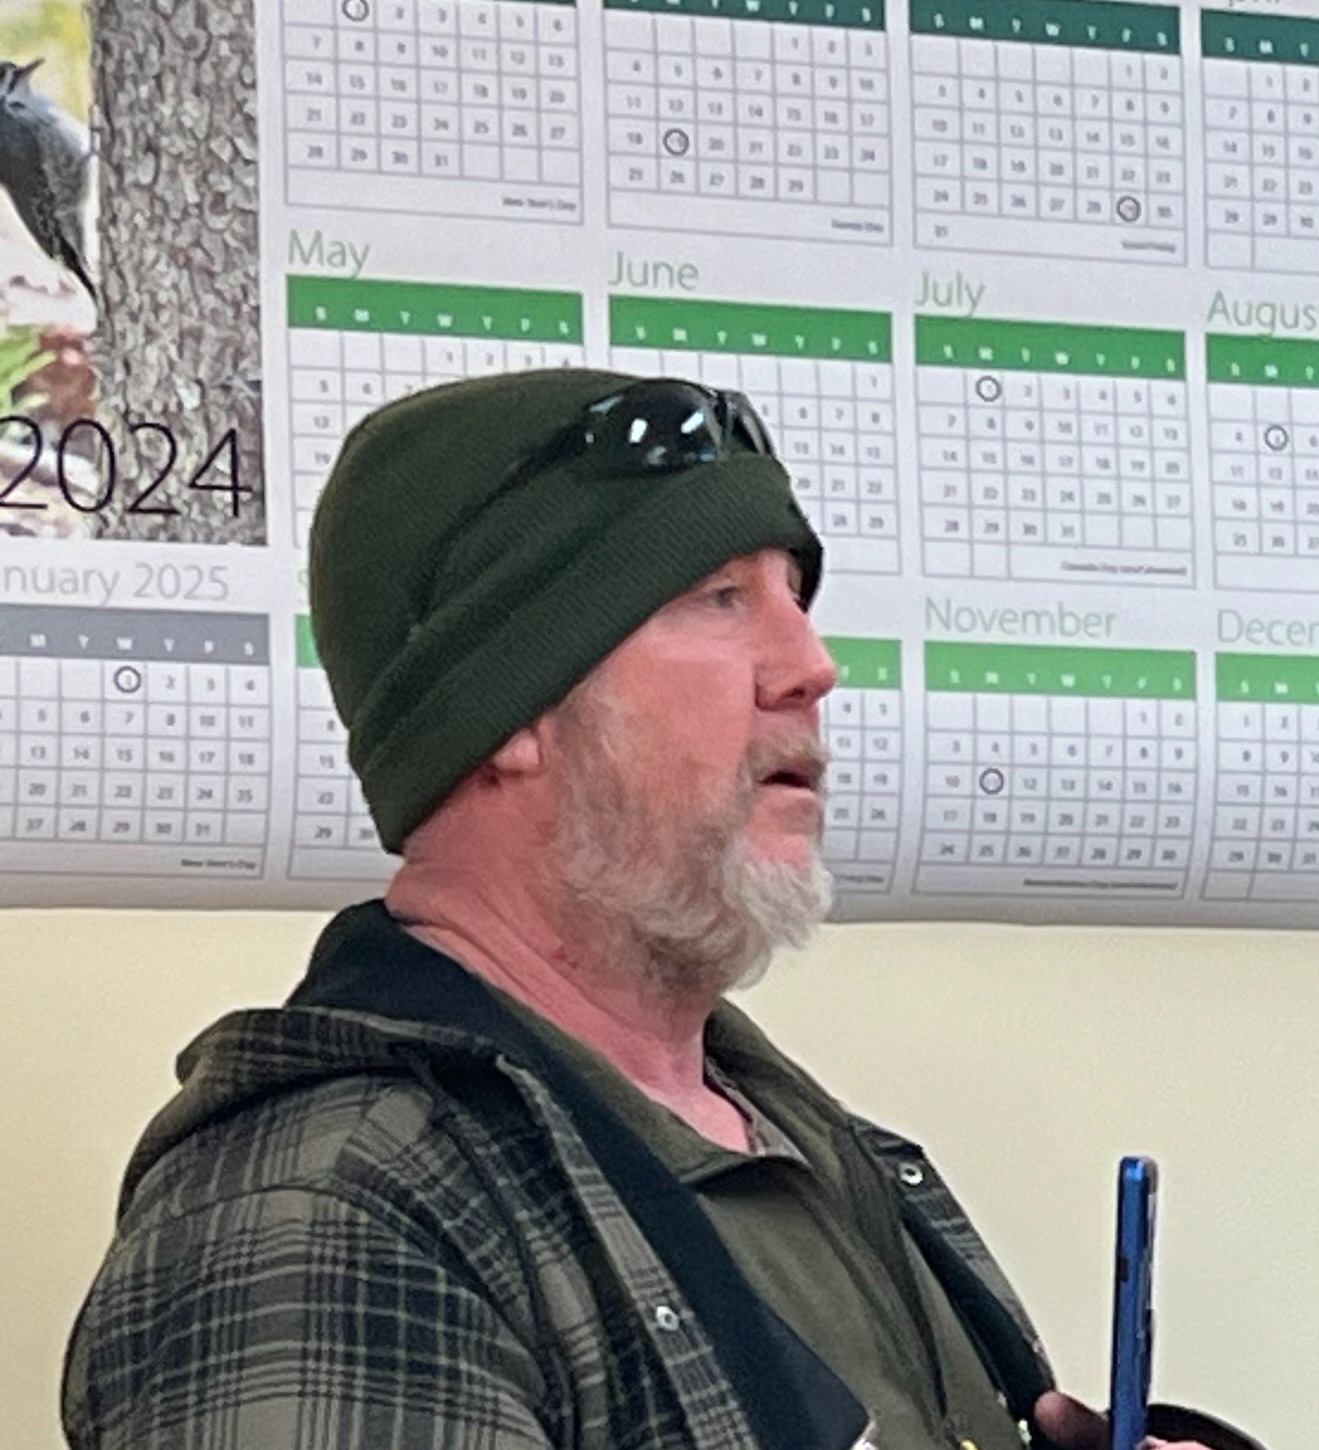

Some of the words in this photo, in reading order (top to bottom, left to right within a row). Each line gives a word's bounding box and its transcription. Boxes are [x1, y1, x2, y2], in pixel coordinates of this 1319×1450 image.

[287, 230, 370, 279] May
[609, 251, 698, 291] June
[914, 271, 986, 315] July
[0, 414, 252, 518] 2024
[3, 561, 119, 604] nuary
[134, 562, 230, 600] 2025
[925, 596, 1116, 640] November
